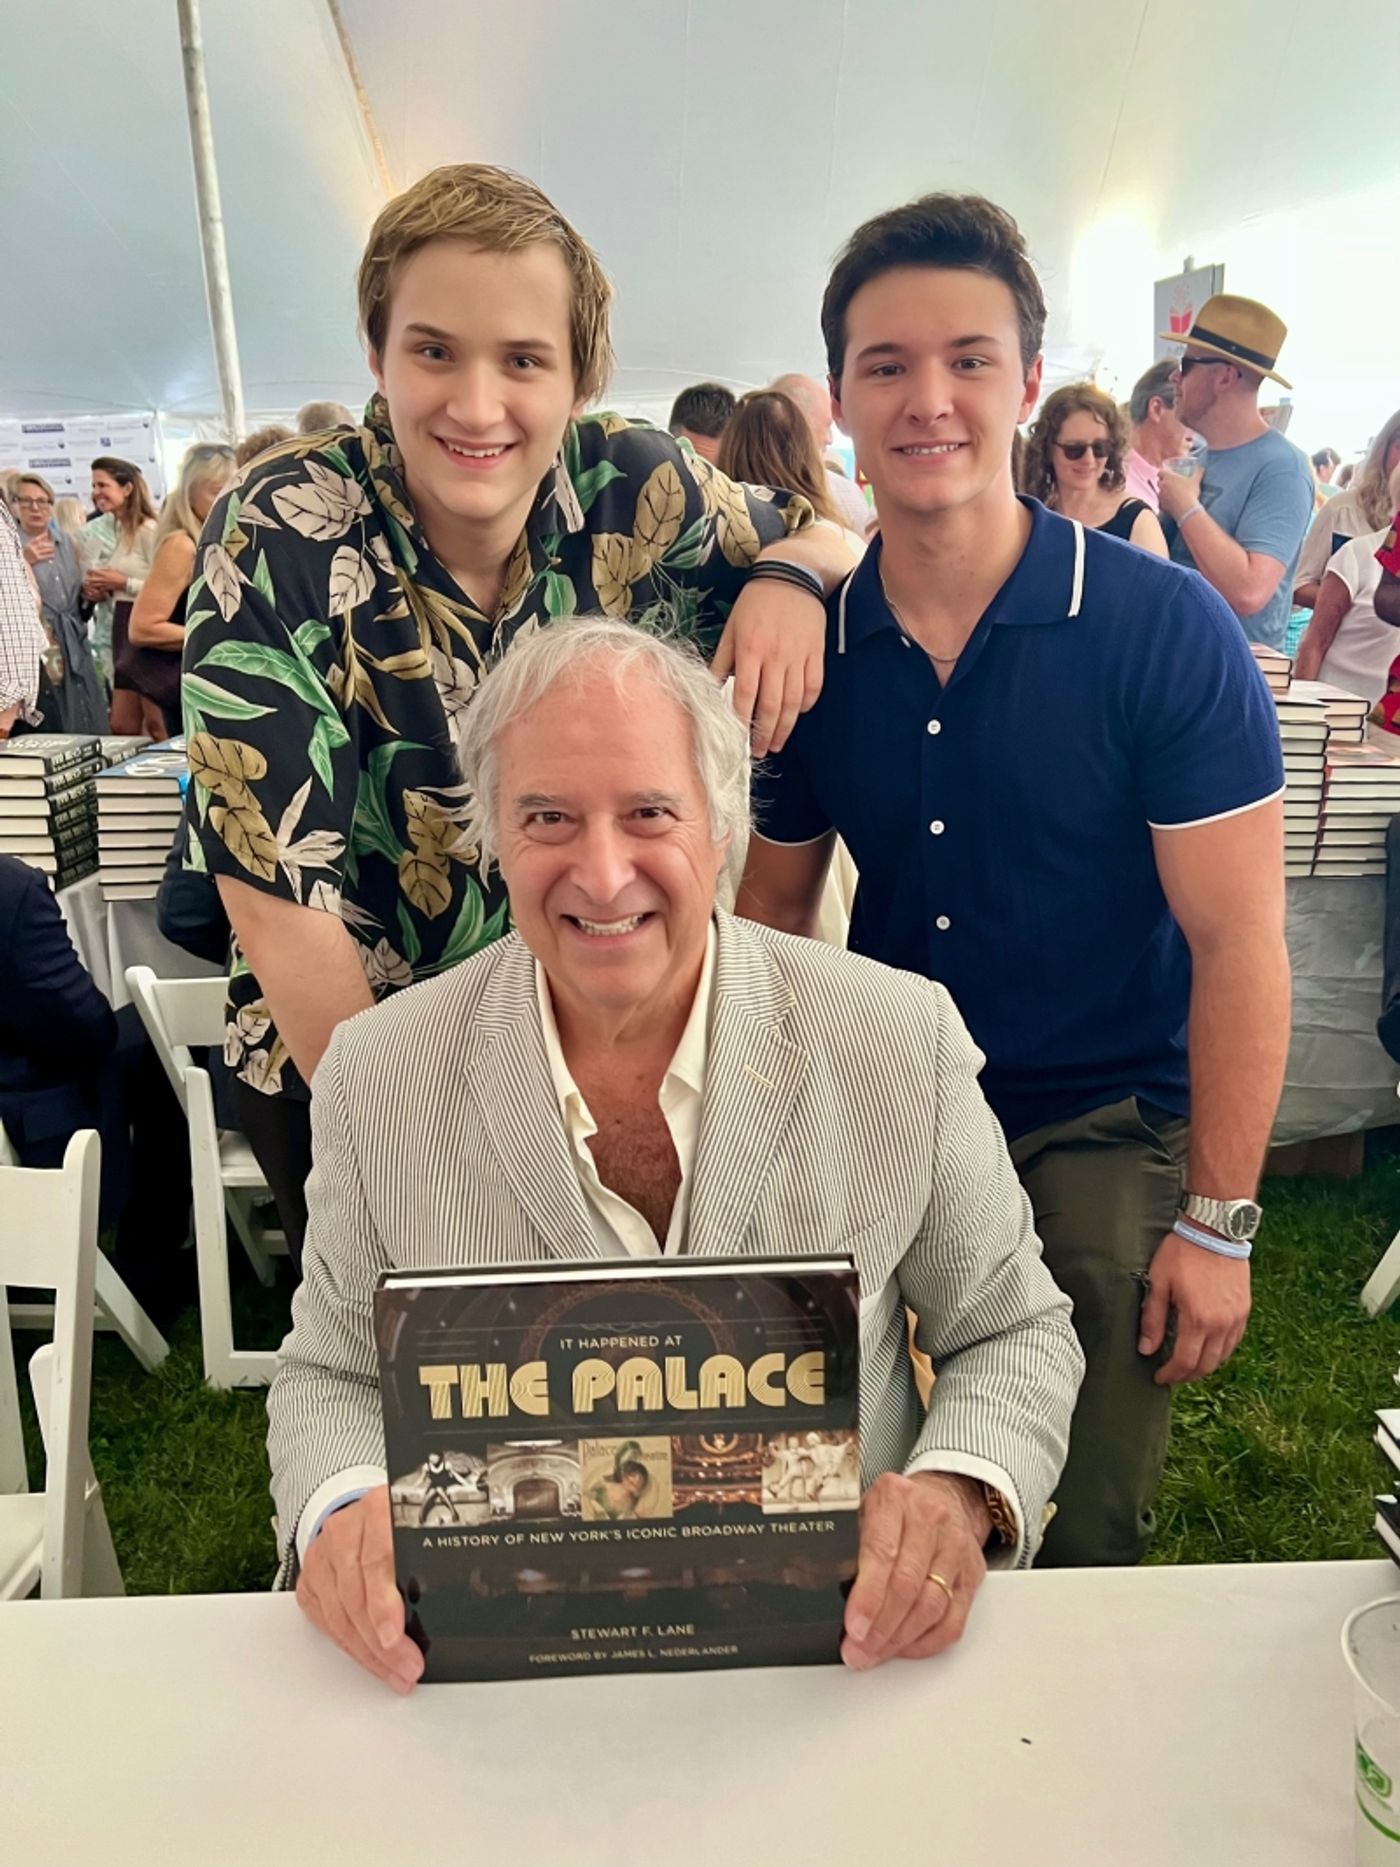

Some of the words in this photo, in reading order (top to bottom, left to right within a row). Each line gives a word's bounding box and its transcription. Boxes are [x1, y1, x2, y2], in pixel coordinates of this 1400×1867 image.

[560, 1338, 574, 1350] IT
[579, 1335, 659, 1349] HAPPENED
[664, 1335, 682, 1346] AT
[419, 1361, 550, 1419] THE
[572, 1351, 825, 1414] PALACE
[422, 1537, 433, 1547] A
[437, 1534, 500, 1548] HISTORY
[504, 1533, 525, 1545] OF
[530, 1531, 565, 1544] NEW
[569, 1529, 622, 1542] YORK'S
[626, 1526, 678, 1540] ICONIC
[681, 1523, 765, 1538] BROADWAY
[770, 1520, 836, 1534] THEATER
[571, 1625, 637, 1640] STEWART
[657, 1623, 695, 1637] LANE
[529, 1651, 591, 1664] FOREWORD
[594, 1651, 608, 1661] BY
[611, 1649, 646, 1659] JAMES
[660, 1645, 739, 1658] NEDERLANDER
